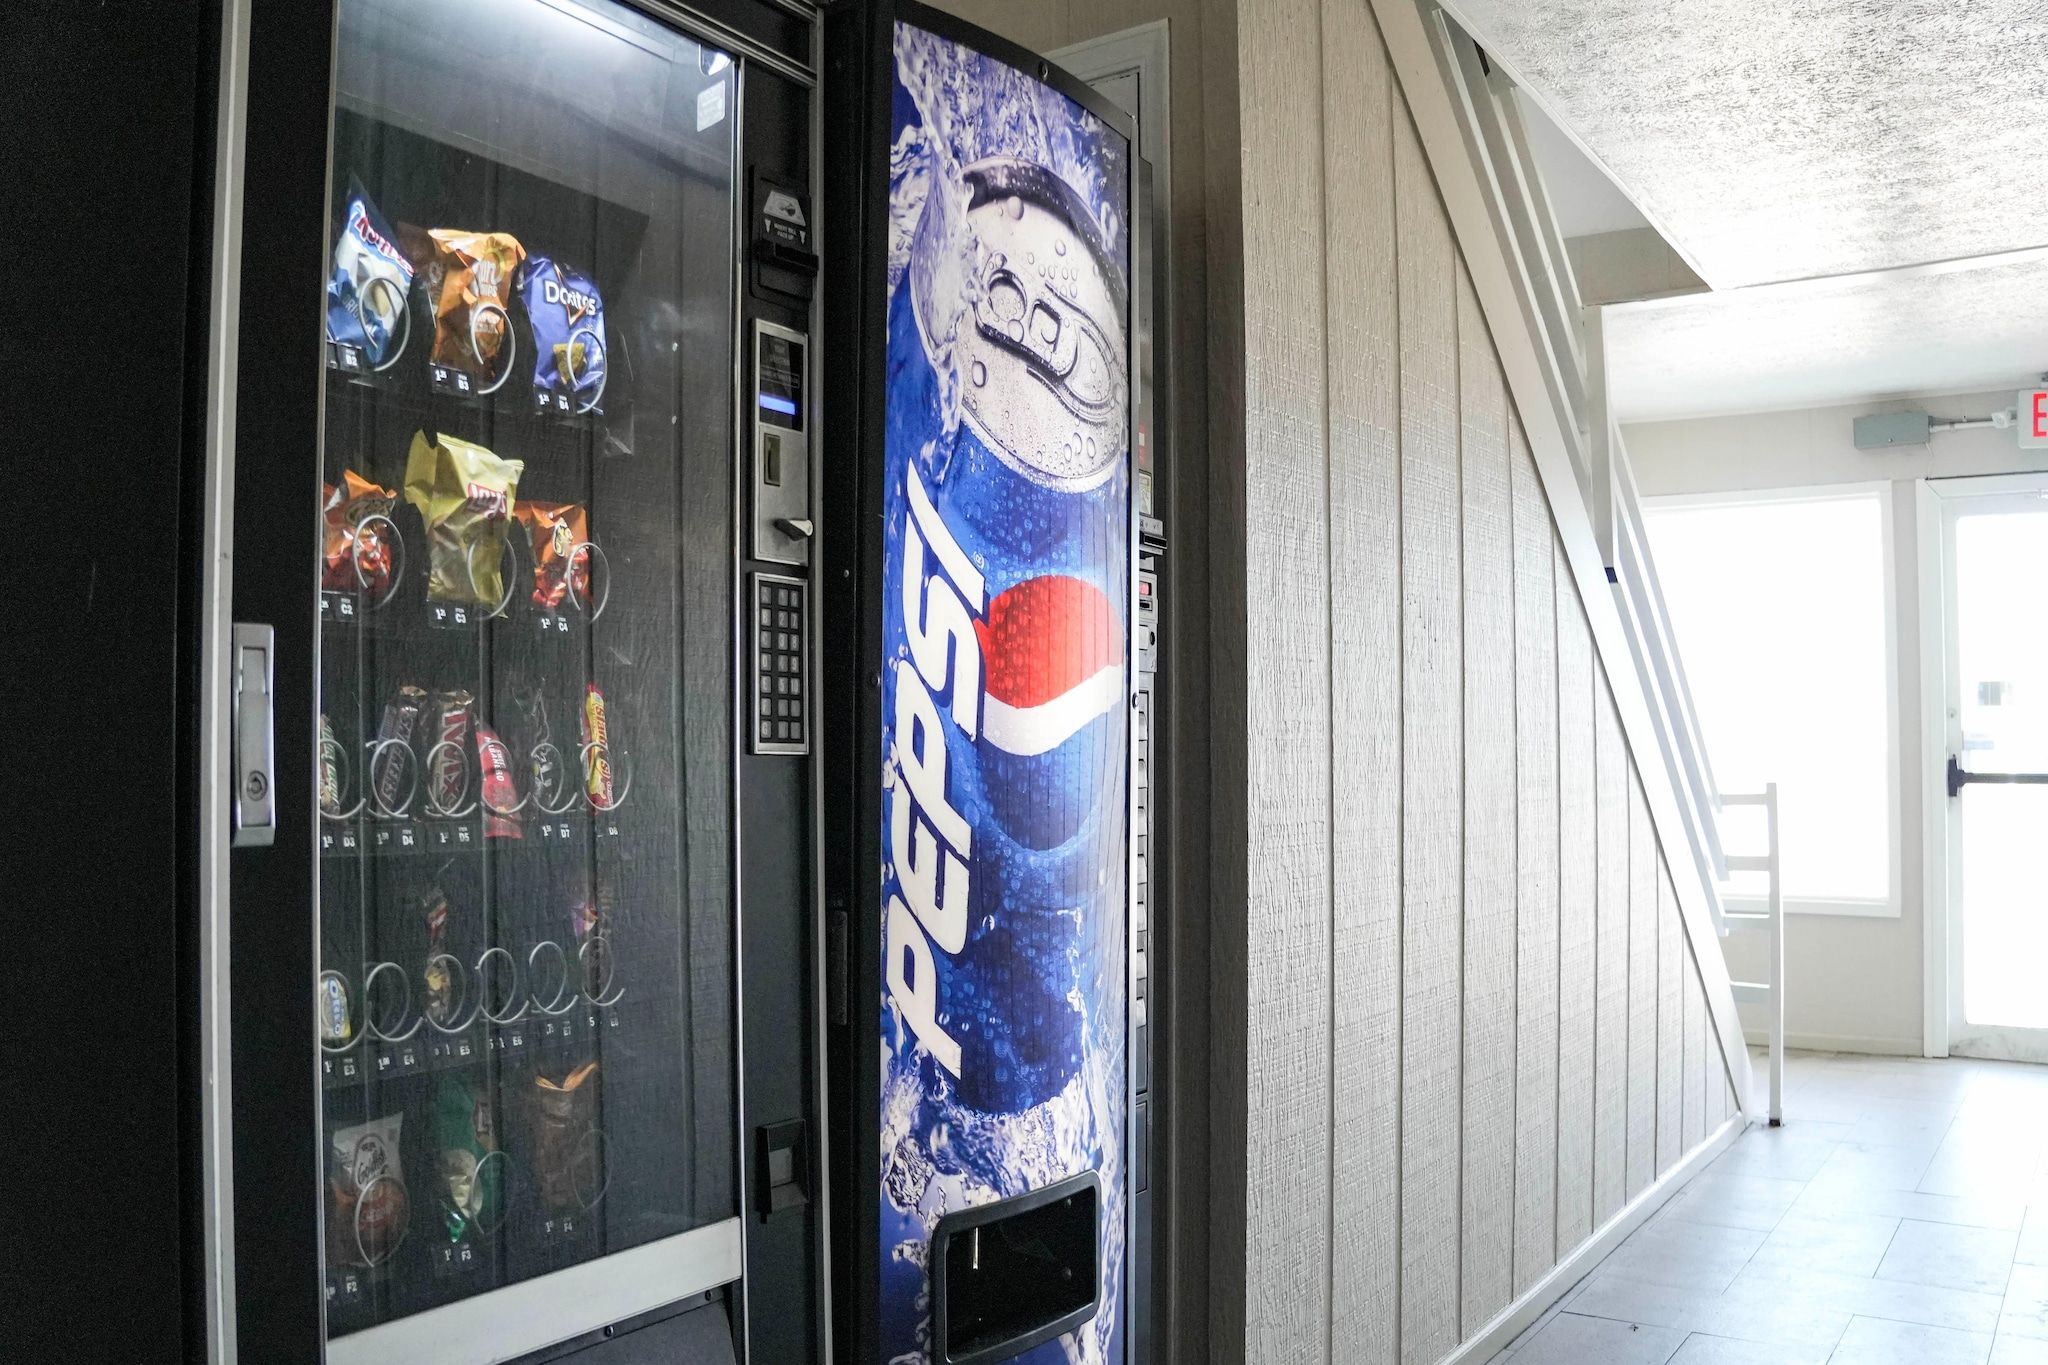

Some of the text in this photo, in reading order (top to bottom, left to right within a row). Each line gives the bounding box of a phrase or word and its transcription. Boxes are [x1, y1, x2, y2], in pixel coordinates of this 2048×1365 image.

[544, 280, 596, 316] Doritos
[341, 603, 353, 615] C2
[455, 613, 467, 624] C3
[886, 457, 985, 1081] PEPSI
[459, 832, 470, 843] D5
[561, 828, 570, 839] D7
[343, 837, 355, 848] D3
[402, 835, 414, 846] D4
[344, 1065, 355, 1076] E3
[461, 1250, 471, 1261] F3
[347, 1281, 357, 1293] F2
